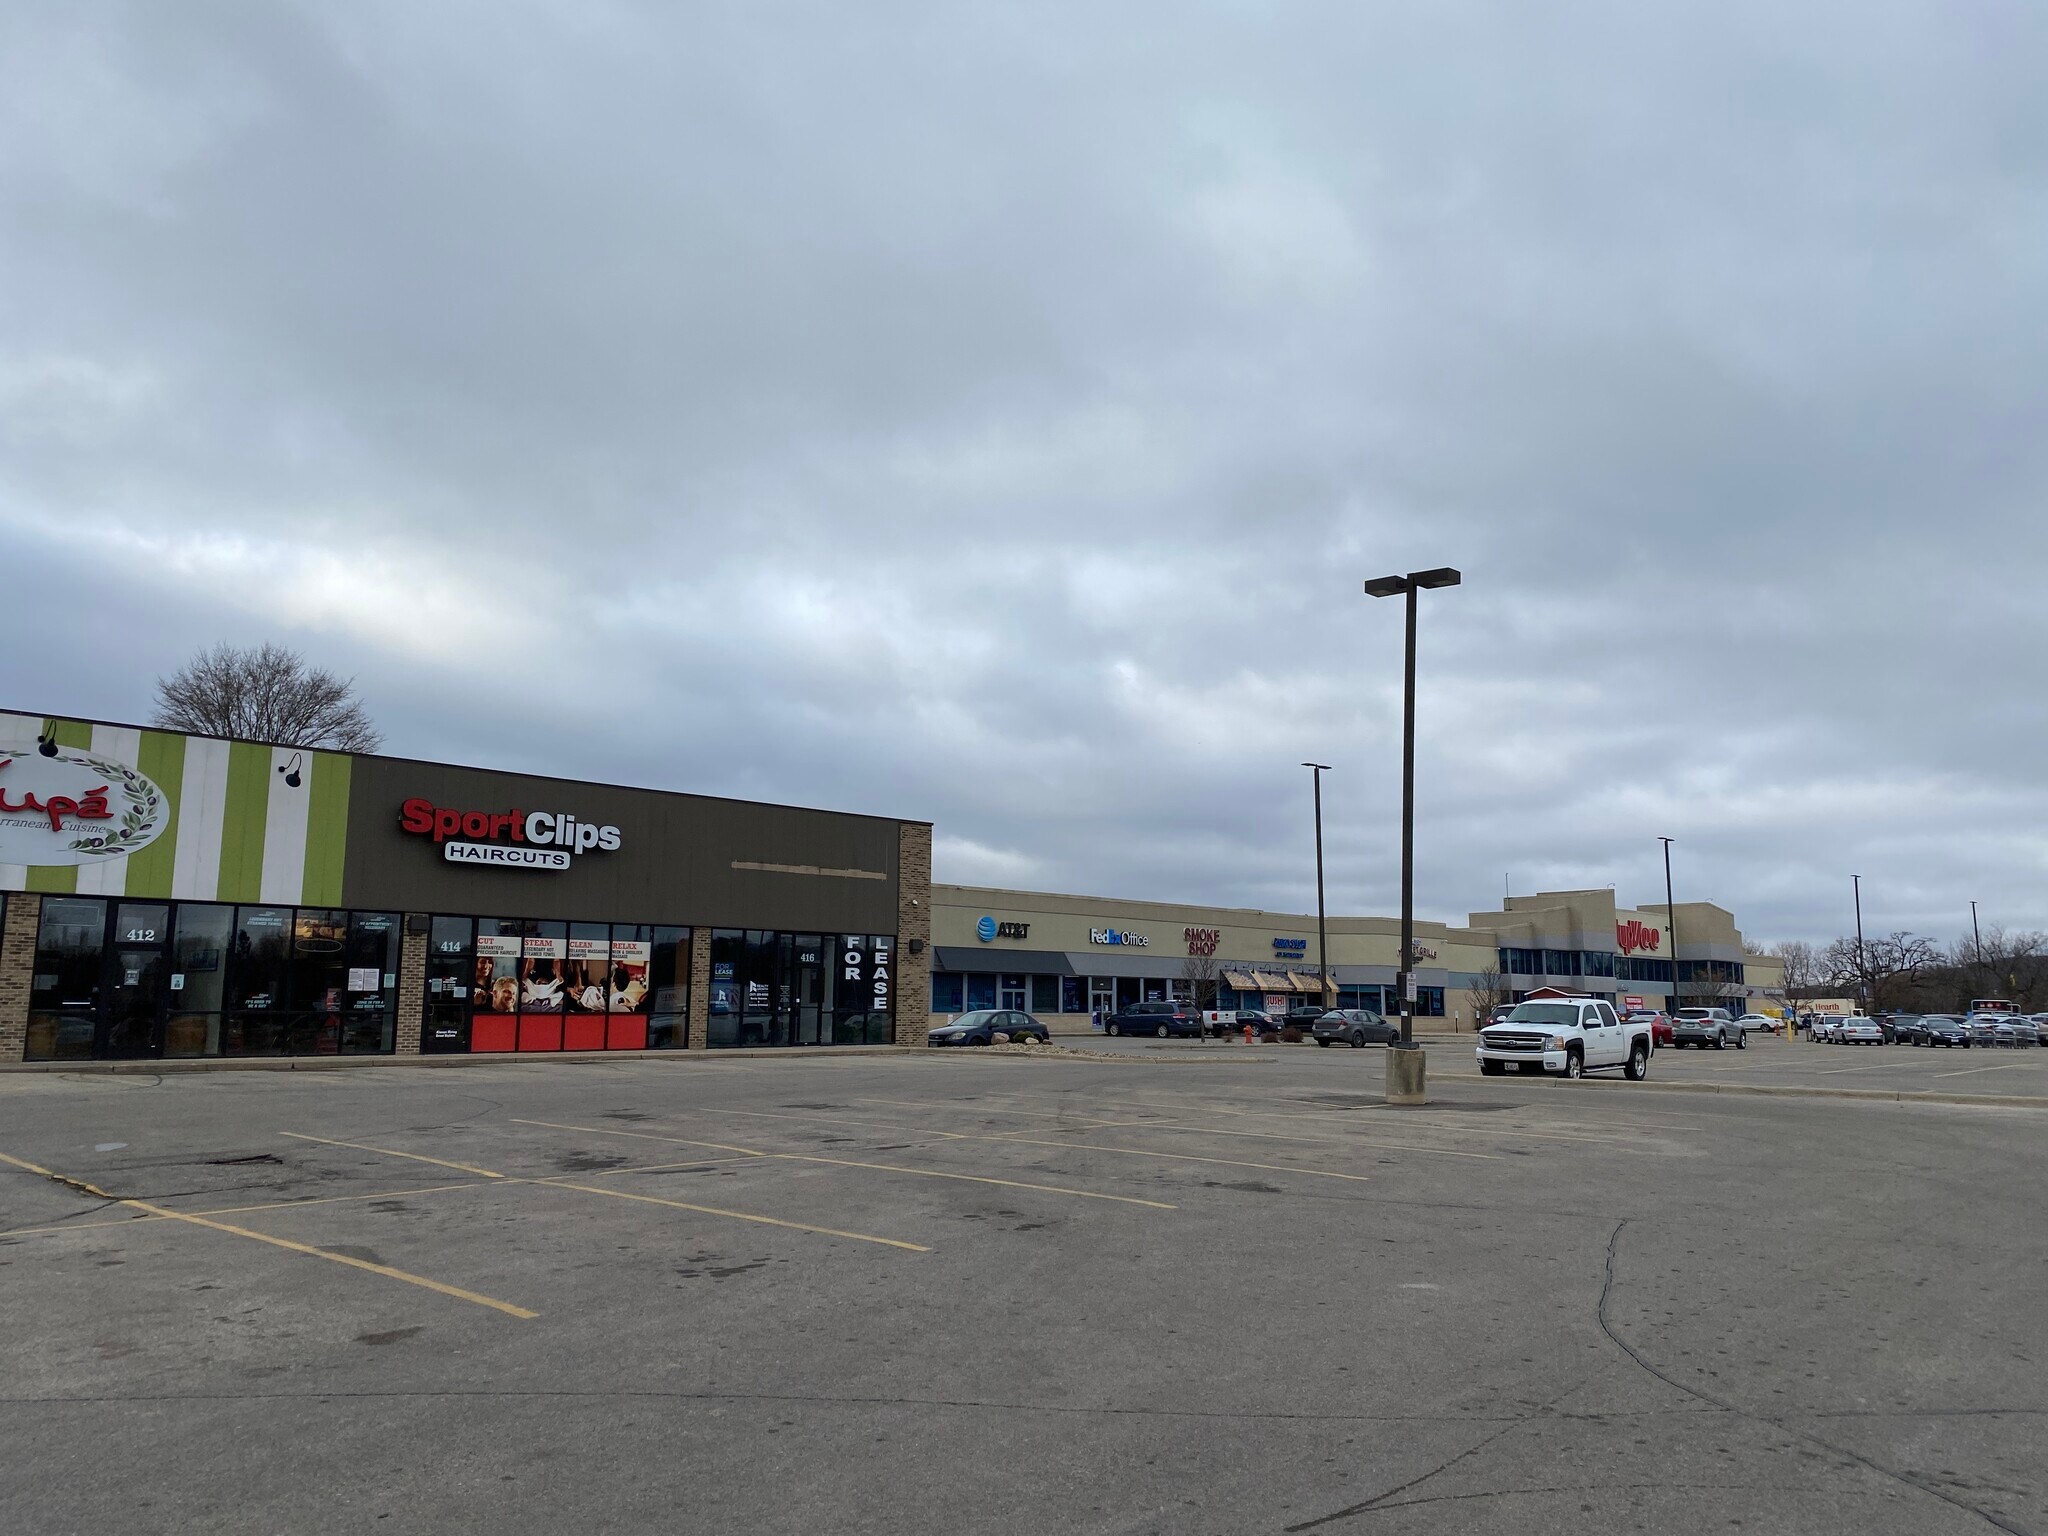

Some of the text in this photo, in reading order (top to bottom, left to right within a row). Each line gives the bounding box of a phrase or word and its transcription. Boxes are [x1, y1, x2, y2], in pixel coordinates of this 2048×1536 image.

[0, 759, 114, 832] upá
[60, 820, 106, 834] Cuisine
[450, 846, 565, 865] HAIRCUTS
[127, 929, 155, 941] 412
[998, 922, 1030, 938] AT&T
[1090, 928, 1148, 946] FedEx Office
[1184, 928, 1220, 942] SMOKE
[441, 942, 461, 952] 414
[1188, 942, 1216, 956] SHOP
[800, 954, 814, 962] 416
[844, 936, 861, 980] FOR
[873, 938, 889, 1010] LEASE
[1267, 996, 1284, 1005] SUSHI
